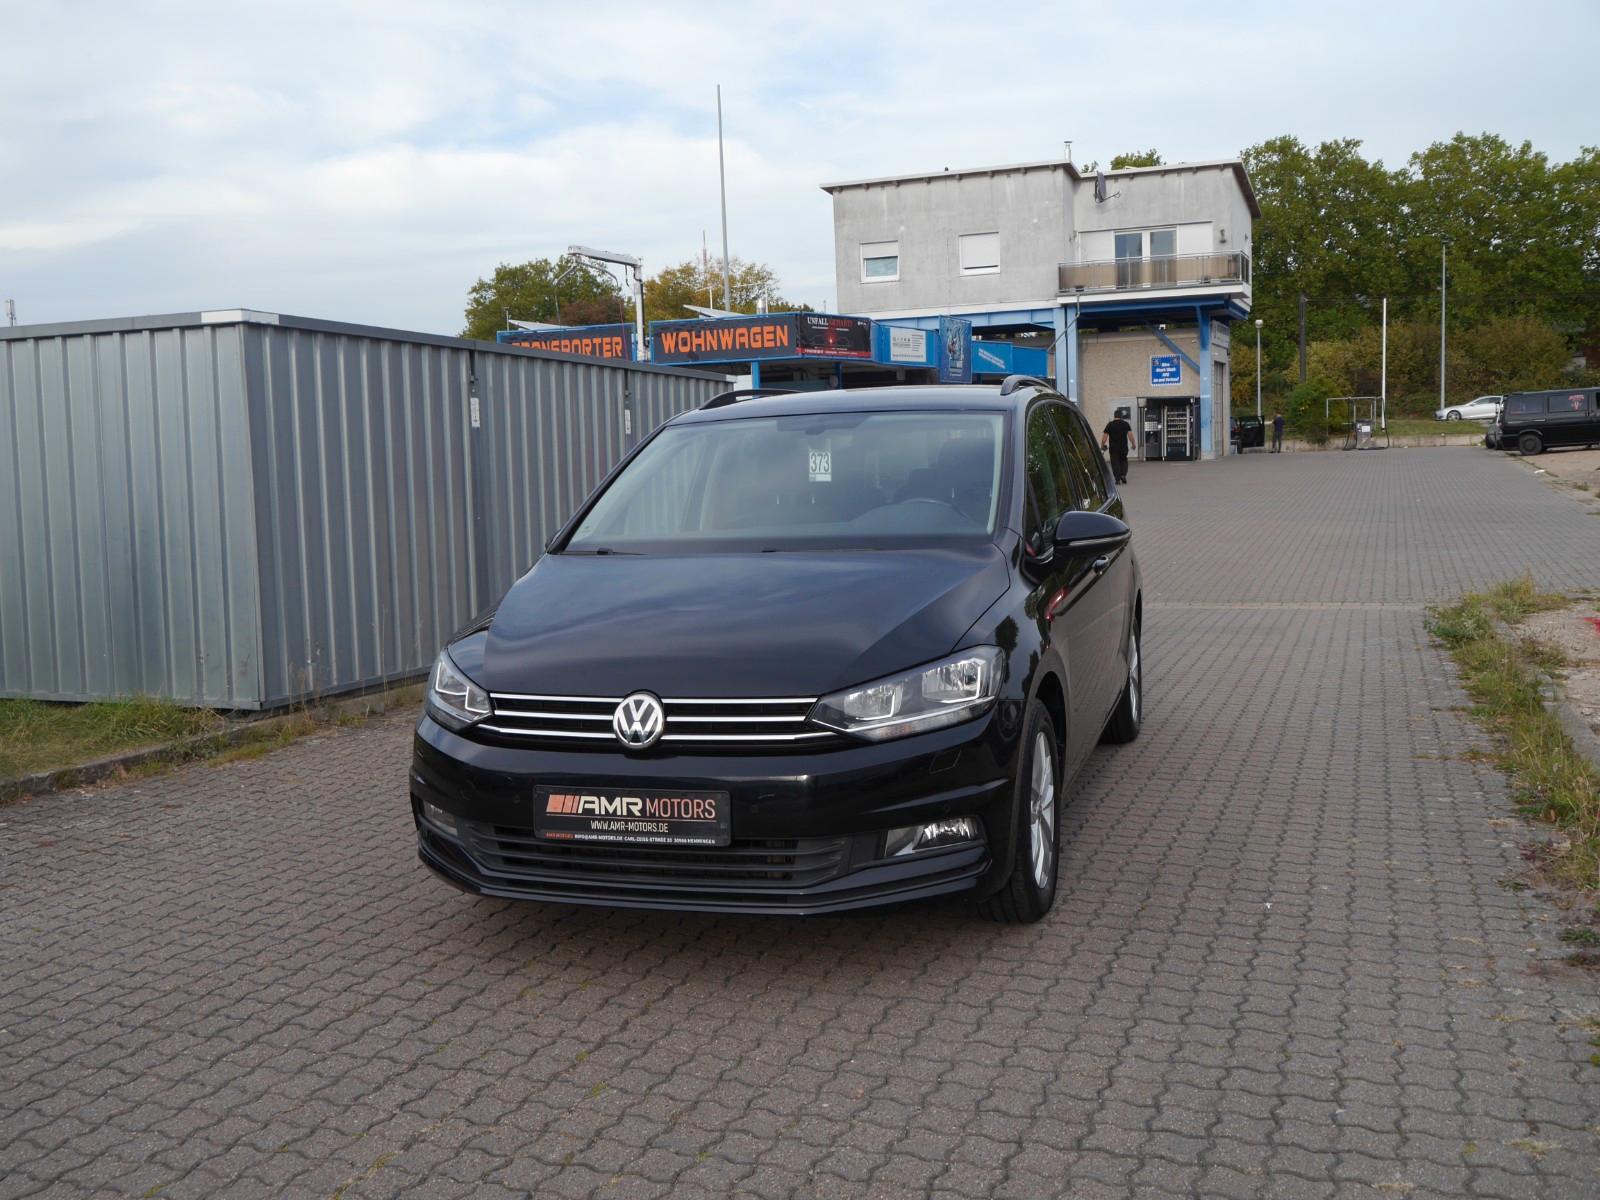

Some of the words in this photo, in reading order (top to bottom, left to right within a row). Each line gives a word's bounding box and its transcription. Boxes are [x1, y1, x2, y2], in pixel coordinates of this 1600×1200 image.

[807, 317, 829, 326] UNFALL
[661, 325, 789, 354] WOHNWAGEN
[810, 452, 830, 472] 373
[577, 795, 643, 816] AMR
[646, 798, 716, 819] MOTORS
[590, 820, 669, 833] WWW.AMR-MOTORS.DE
